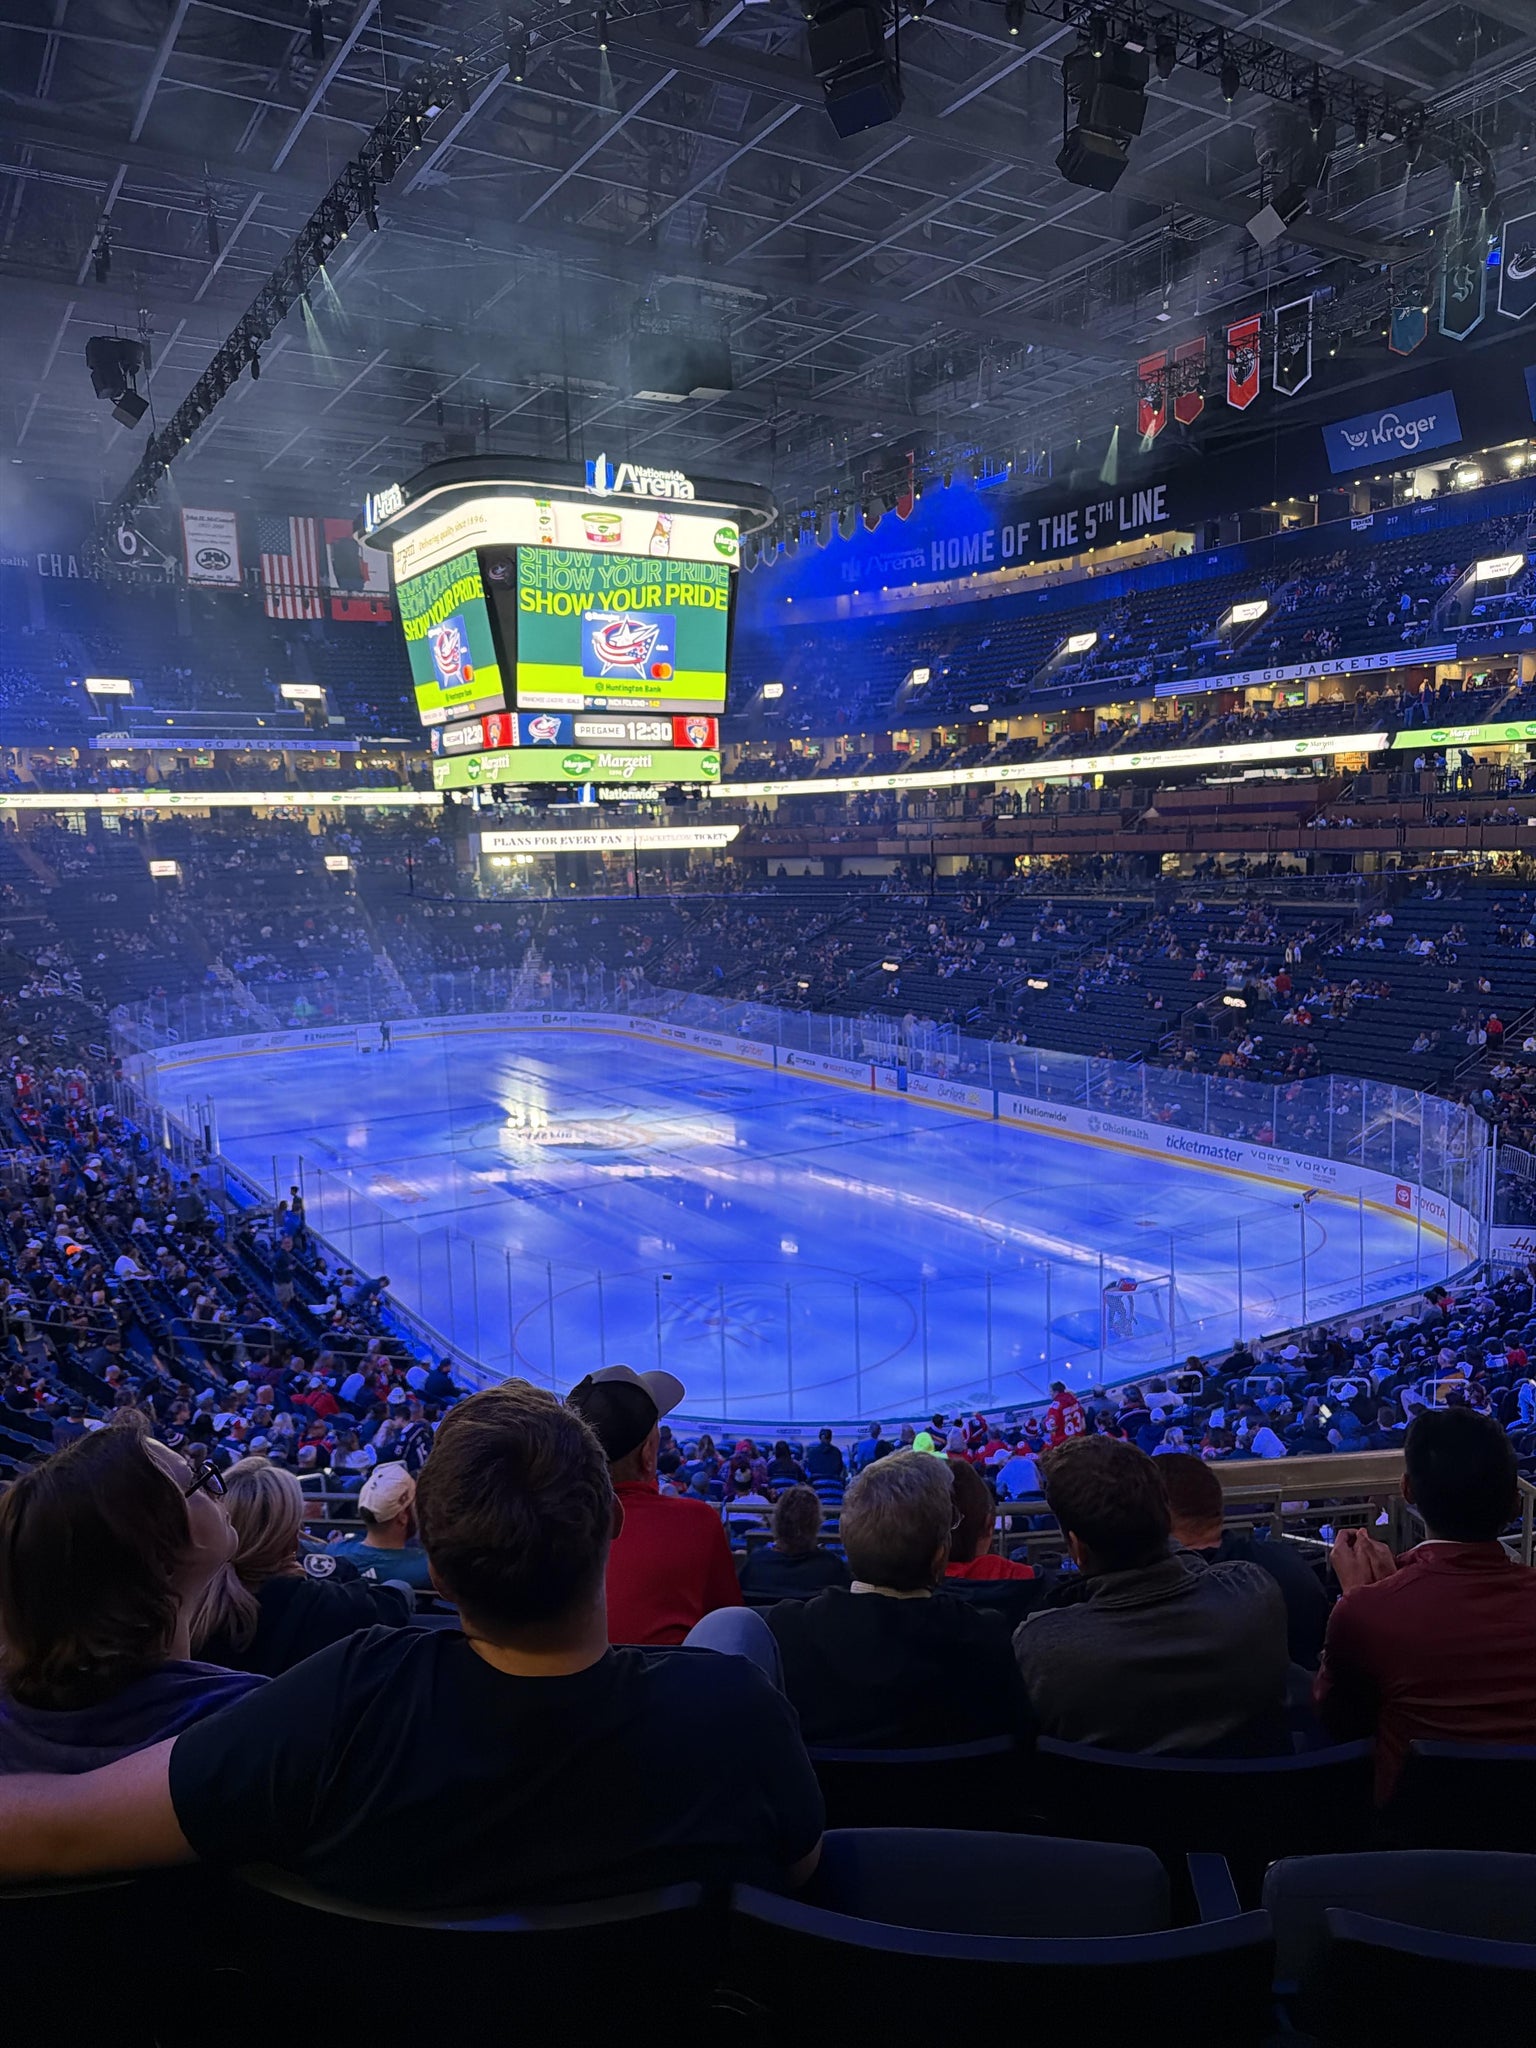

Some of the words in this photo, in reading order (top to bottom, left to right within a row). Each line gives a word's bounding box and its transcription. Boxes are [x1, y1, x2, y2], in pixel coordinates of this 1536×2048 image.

[1371, 413, 1437, 450] Kroger
[614, 462, 695, 500] Arena
[634, 465, 685, 481] Nationwide
[117, 526, 138, 556] 6
[931, 530, 995, 571] HOME
[1002, 522, 1030, 558] OF
[1038, 510, 1078, 550] THE
[1085, 500, 1113, 540] 5TH
[520, 561, 594, 591] SHOW
[598, 560, 661, 589] YOUR
[666, 559, 730, 587] PRIDE
[403, 611, 430, 642] SHOW
[428, 589, 456, 626] YOUR
[452, 575, 485, 607] PRIDE
[520, 587, 594, 616] SHOW
[598, 584, 661, 612] YOUR
[665, 583, 729, 611] PRIDE
[1205, 673, 1250, 689] LET'S
[1263, 669, 1285, 680] GO
[1295, 654, 1389, 676] JACKETS
[605, 682, 643, 694] Huntington
[580, 726, 621, 735] PREGAME
[626, 722, 673, 742] 12:30
[204, 740, 225, 748] GO
[233, 741, 312, 749] JACKETS
[598, 753, 652, 778] Marzetti
[599, 786, 660, 801] Nationwide
[493, 836, 532, 847] PLANS
[534, 836, 558, 846] FOR
[560, 835, 598, 846] EVERY
[601, 834, 622, 845] FAN
[1024, 1105, 1067, 1122] Nationwide
[1102, 1122, 1149, 1140] OhioHealth
[1165, 1134, 1244, 1162] ticketmaster
[1251, 1150, 1290, 1165] VORYS
[1296, 1160, 1337, 1176] VORYS
[1414, 1195, 1446, 1219] TOYOTA
